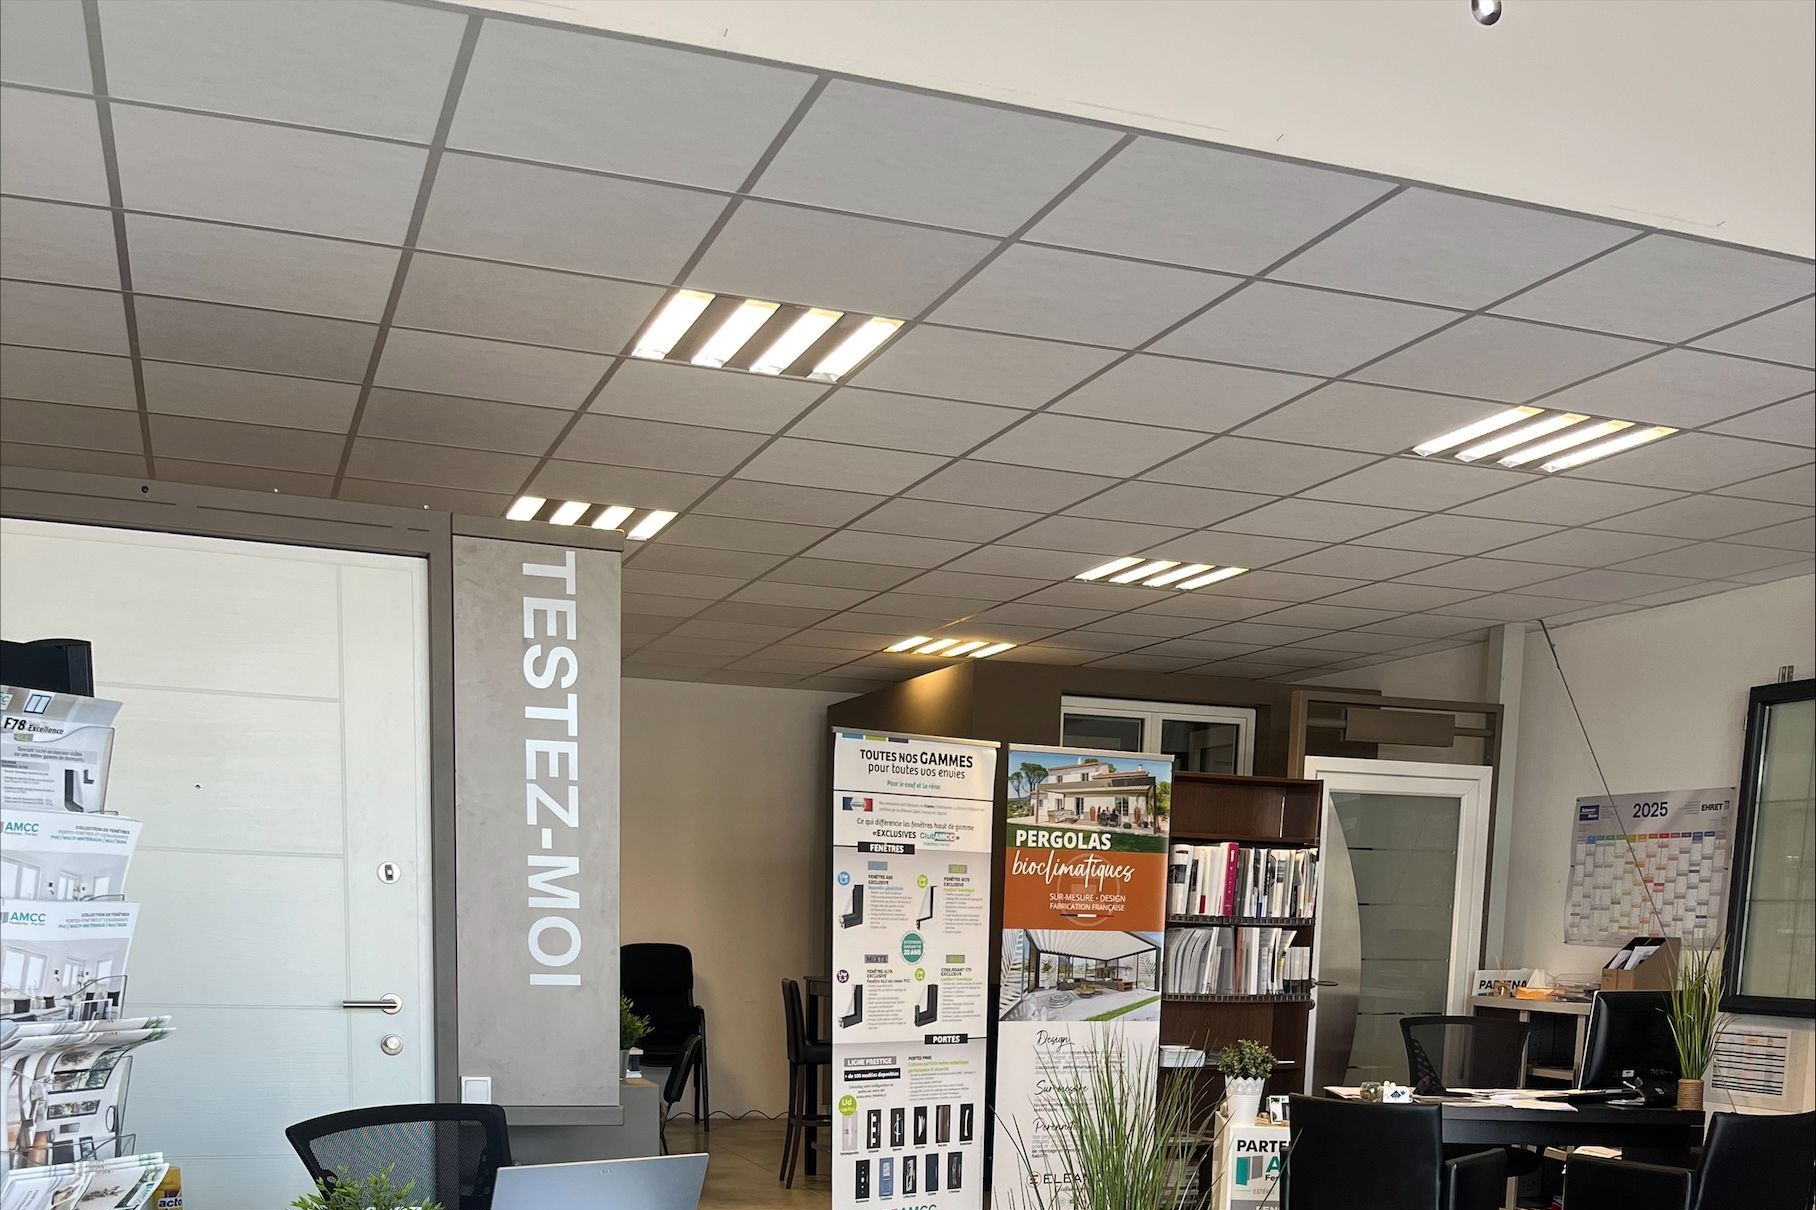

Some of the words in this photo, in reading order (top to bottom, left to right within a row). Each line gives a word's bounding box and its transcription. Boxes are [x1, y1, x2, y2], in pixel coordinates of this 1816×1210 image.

[4, 717, 27, 730] F78
[28, 724, 64, 735] Excellence
[860, 749, 897, 762] TOUTES
[899, 752, 918, 764] NOS
[920, 752, 973, 768] GAMMES
[522, 551, 582, 986] TESTEZ-MOI
[868, 763, 890, 775] pour
[892, 763, 919, 776] toutes
[920, 768, 937, 777] vos
[938, 768, 966, 779] envies
[1632, 801, 1668, 818] 2025
[1701, 803, 1723, 811] EHRET
[5, 822, 39, 833] AMCC
[1015, 829, 1112, 850] PERGOLAS
[869, 842, 905, 853] FENÊTRES
[1012, 850, 1136, 892] bioclimatiques
[1049, 893, 1094, 902] SUR-MESURE
[1100, 894, 1126, 903] DESIGN
[1049, 902, 1091, 910] FABRICATION
[1092, 903, 1125, 912] FRANÇAISE
[10, 912, 46, 922] AMCC
[866, 955, 887, 963] MIXTE
[1479, 980, 1527, 990] PANA
[932, 1035, 960, 1044] PORTES
[1036, 1030, 1075, 1052] Design
[866, 1057, 892, 1065] PRESTIGE
[1237, 1139, 1291, 1152] PARTE
